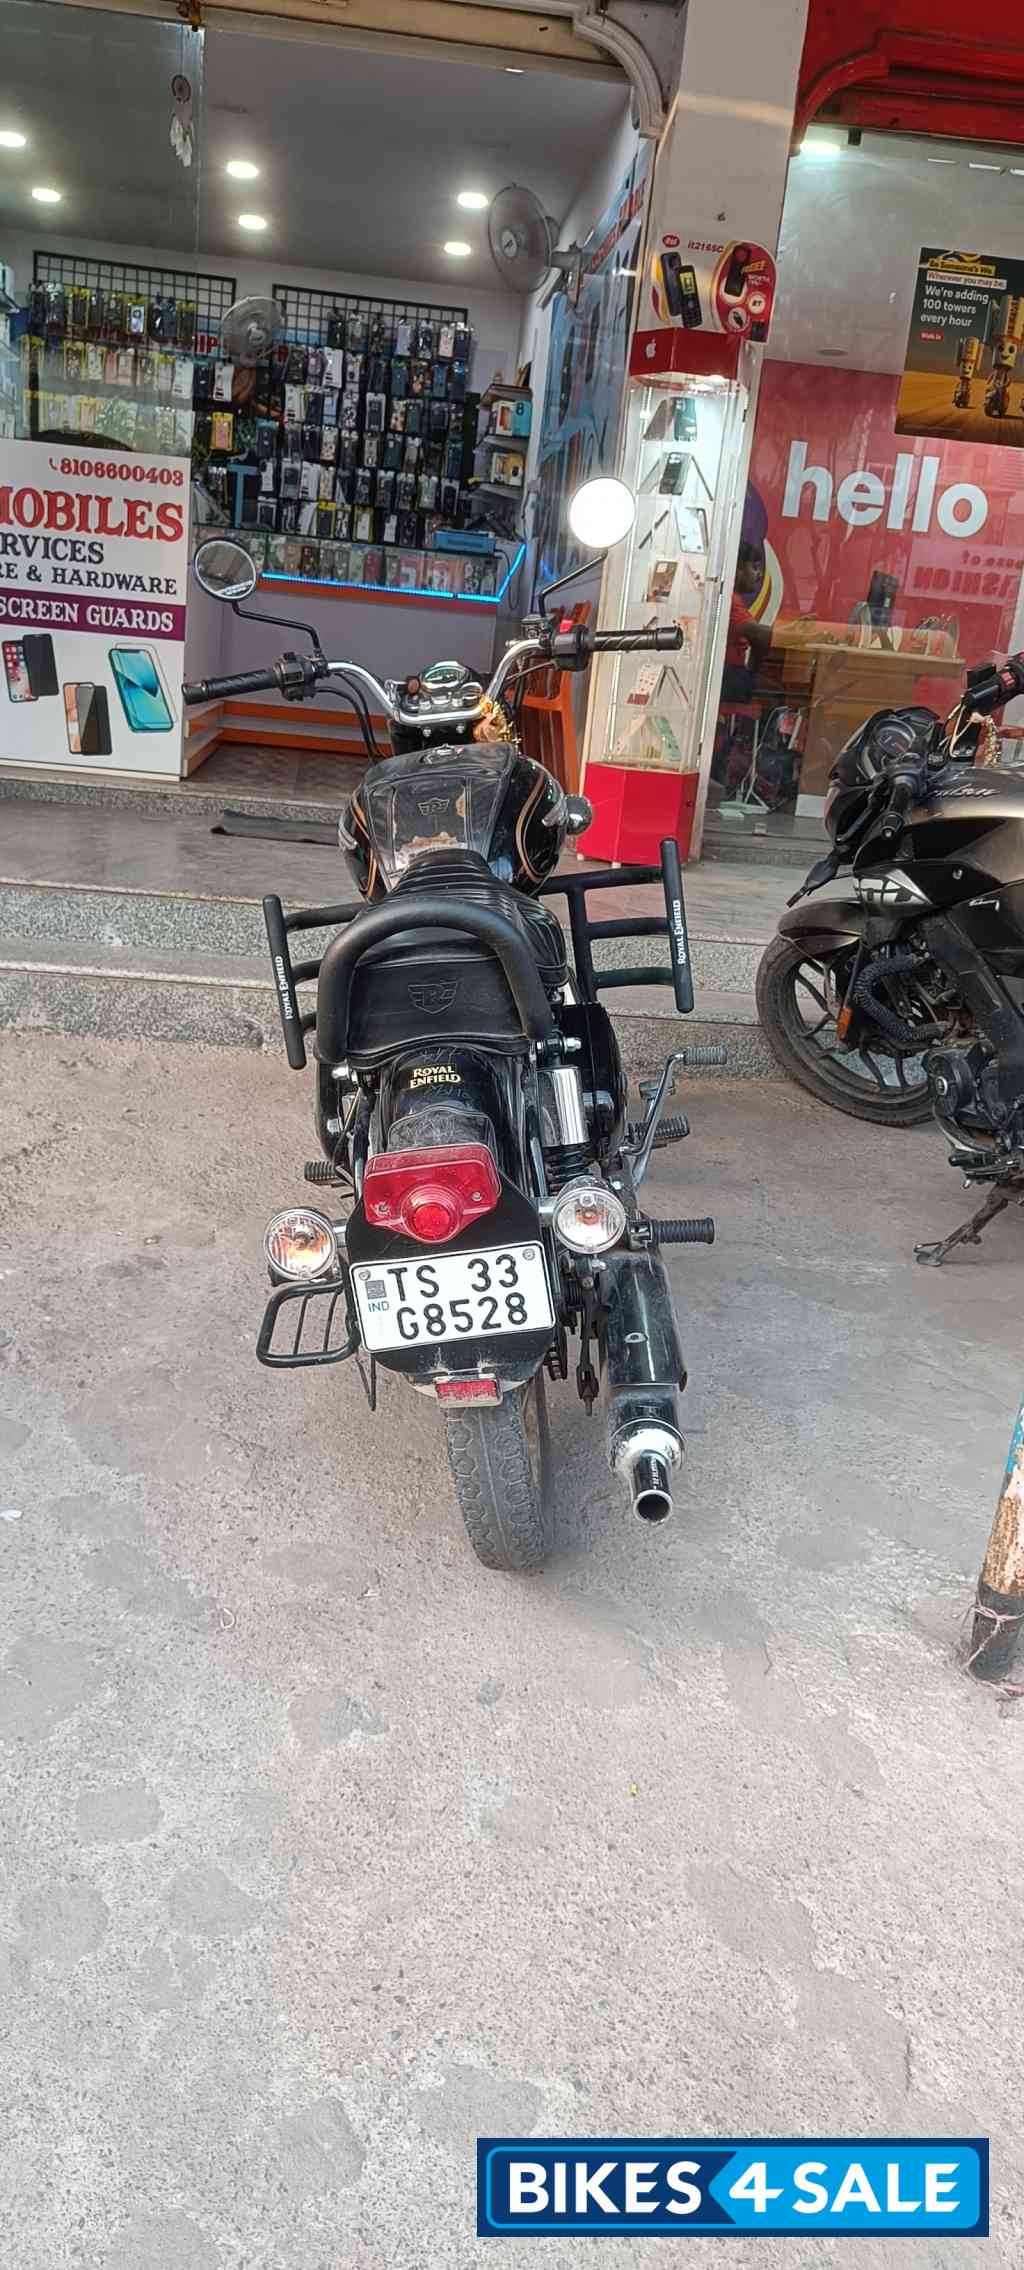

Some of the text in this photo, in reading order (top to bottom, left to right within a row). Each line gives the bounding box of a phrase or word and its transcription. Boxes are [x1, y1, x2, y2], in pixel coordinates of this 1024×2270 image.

[923, 298, 976, 314] 100 towers
[925, 285, 989, 304] We're adding
[920, 314, 973, 327] every hour
[782, 440, 988, 537] hello
[26, 564, 42, 582] &
[52, 567, 177, 595] HARDWARE
[86, 604, 174, 633] GUARDS
[672, 899, 687, 965] ROYAL ENFIELD
[274, 955, 294, 1020] ROYAL ENFIELD
[409, 1073, 462, 1090] ENFIELD
[412, 1065, 456, 1079] ROYAL
[387, 1253, 520, 1302] TS 33
[368, 1300, 390, 1313] IND
[396, 1292, 528, 1341] G8528
